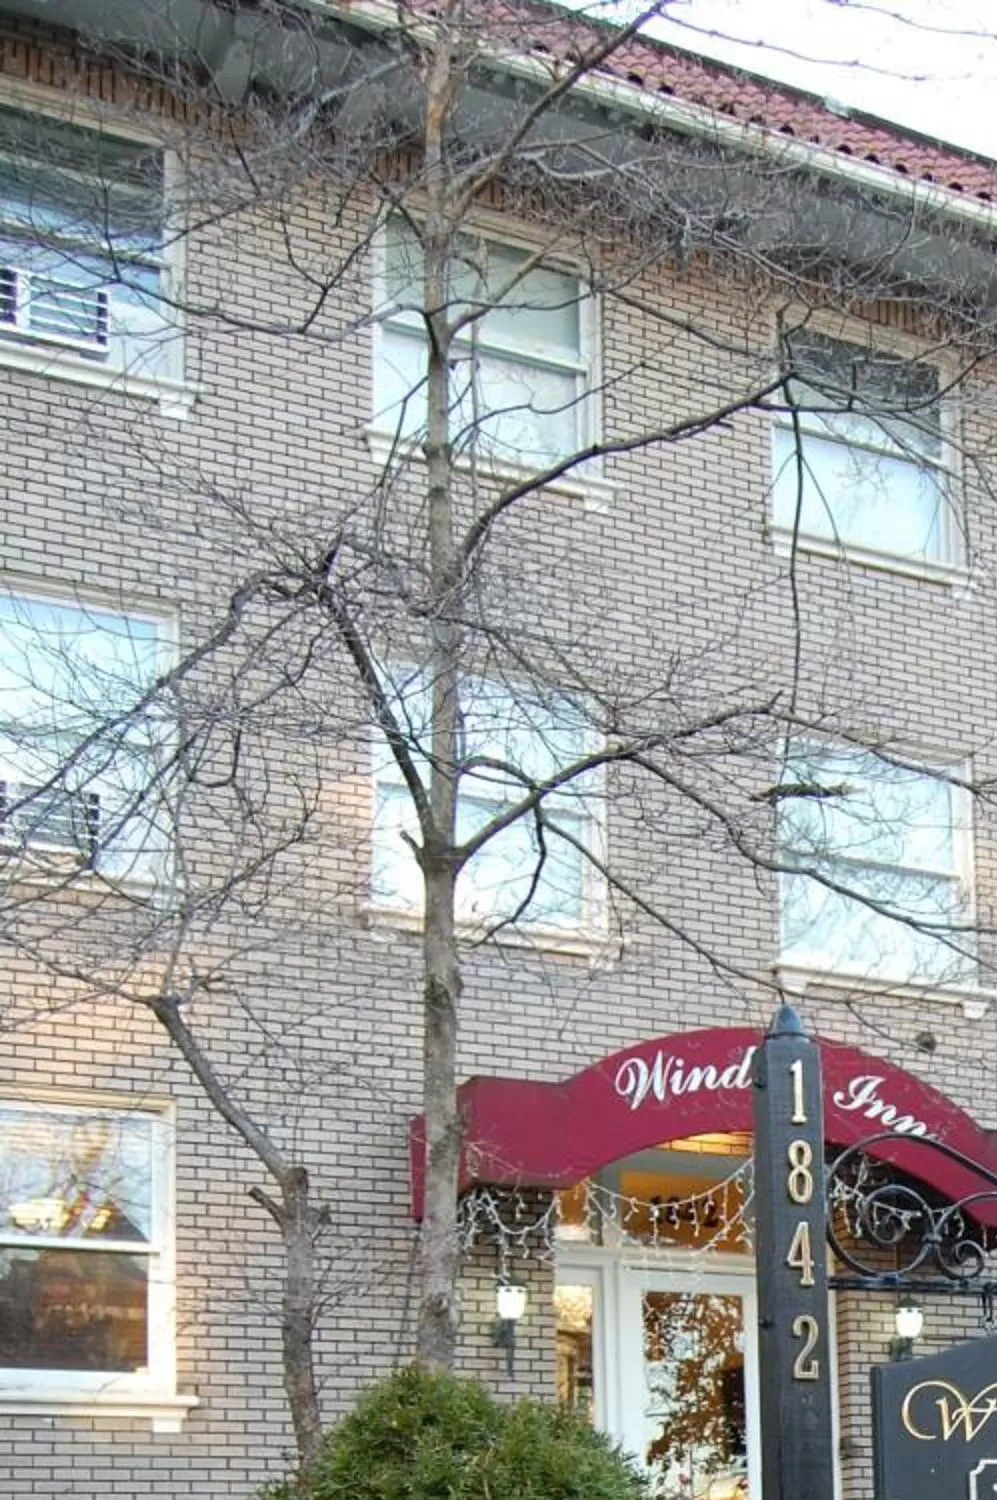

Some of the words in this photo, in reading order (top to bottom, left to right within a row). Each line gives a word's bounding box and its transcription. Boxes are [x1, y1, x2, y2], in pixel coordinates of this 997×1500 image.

[614, 1046, 757, 1111] Wind
[833, 1074, 934, 1141] Inn
[785, 1059, 820, 1380] 1842
